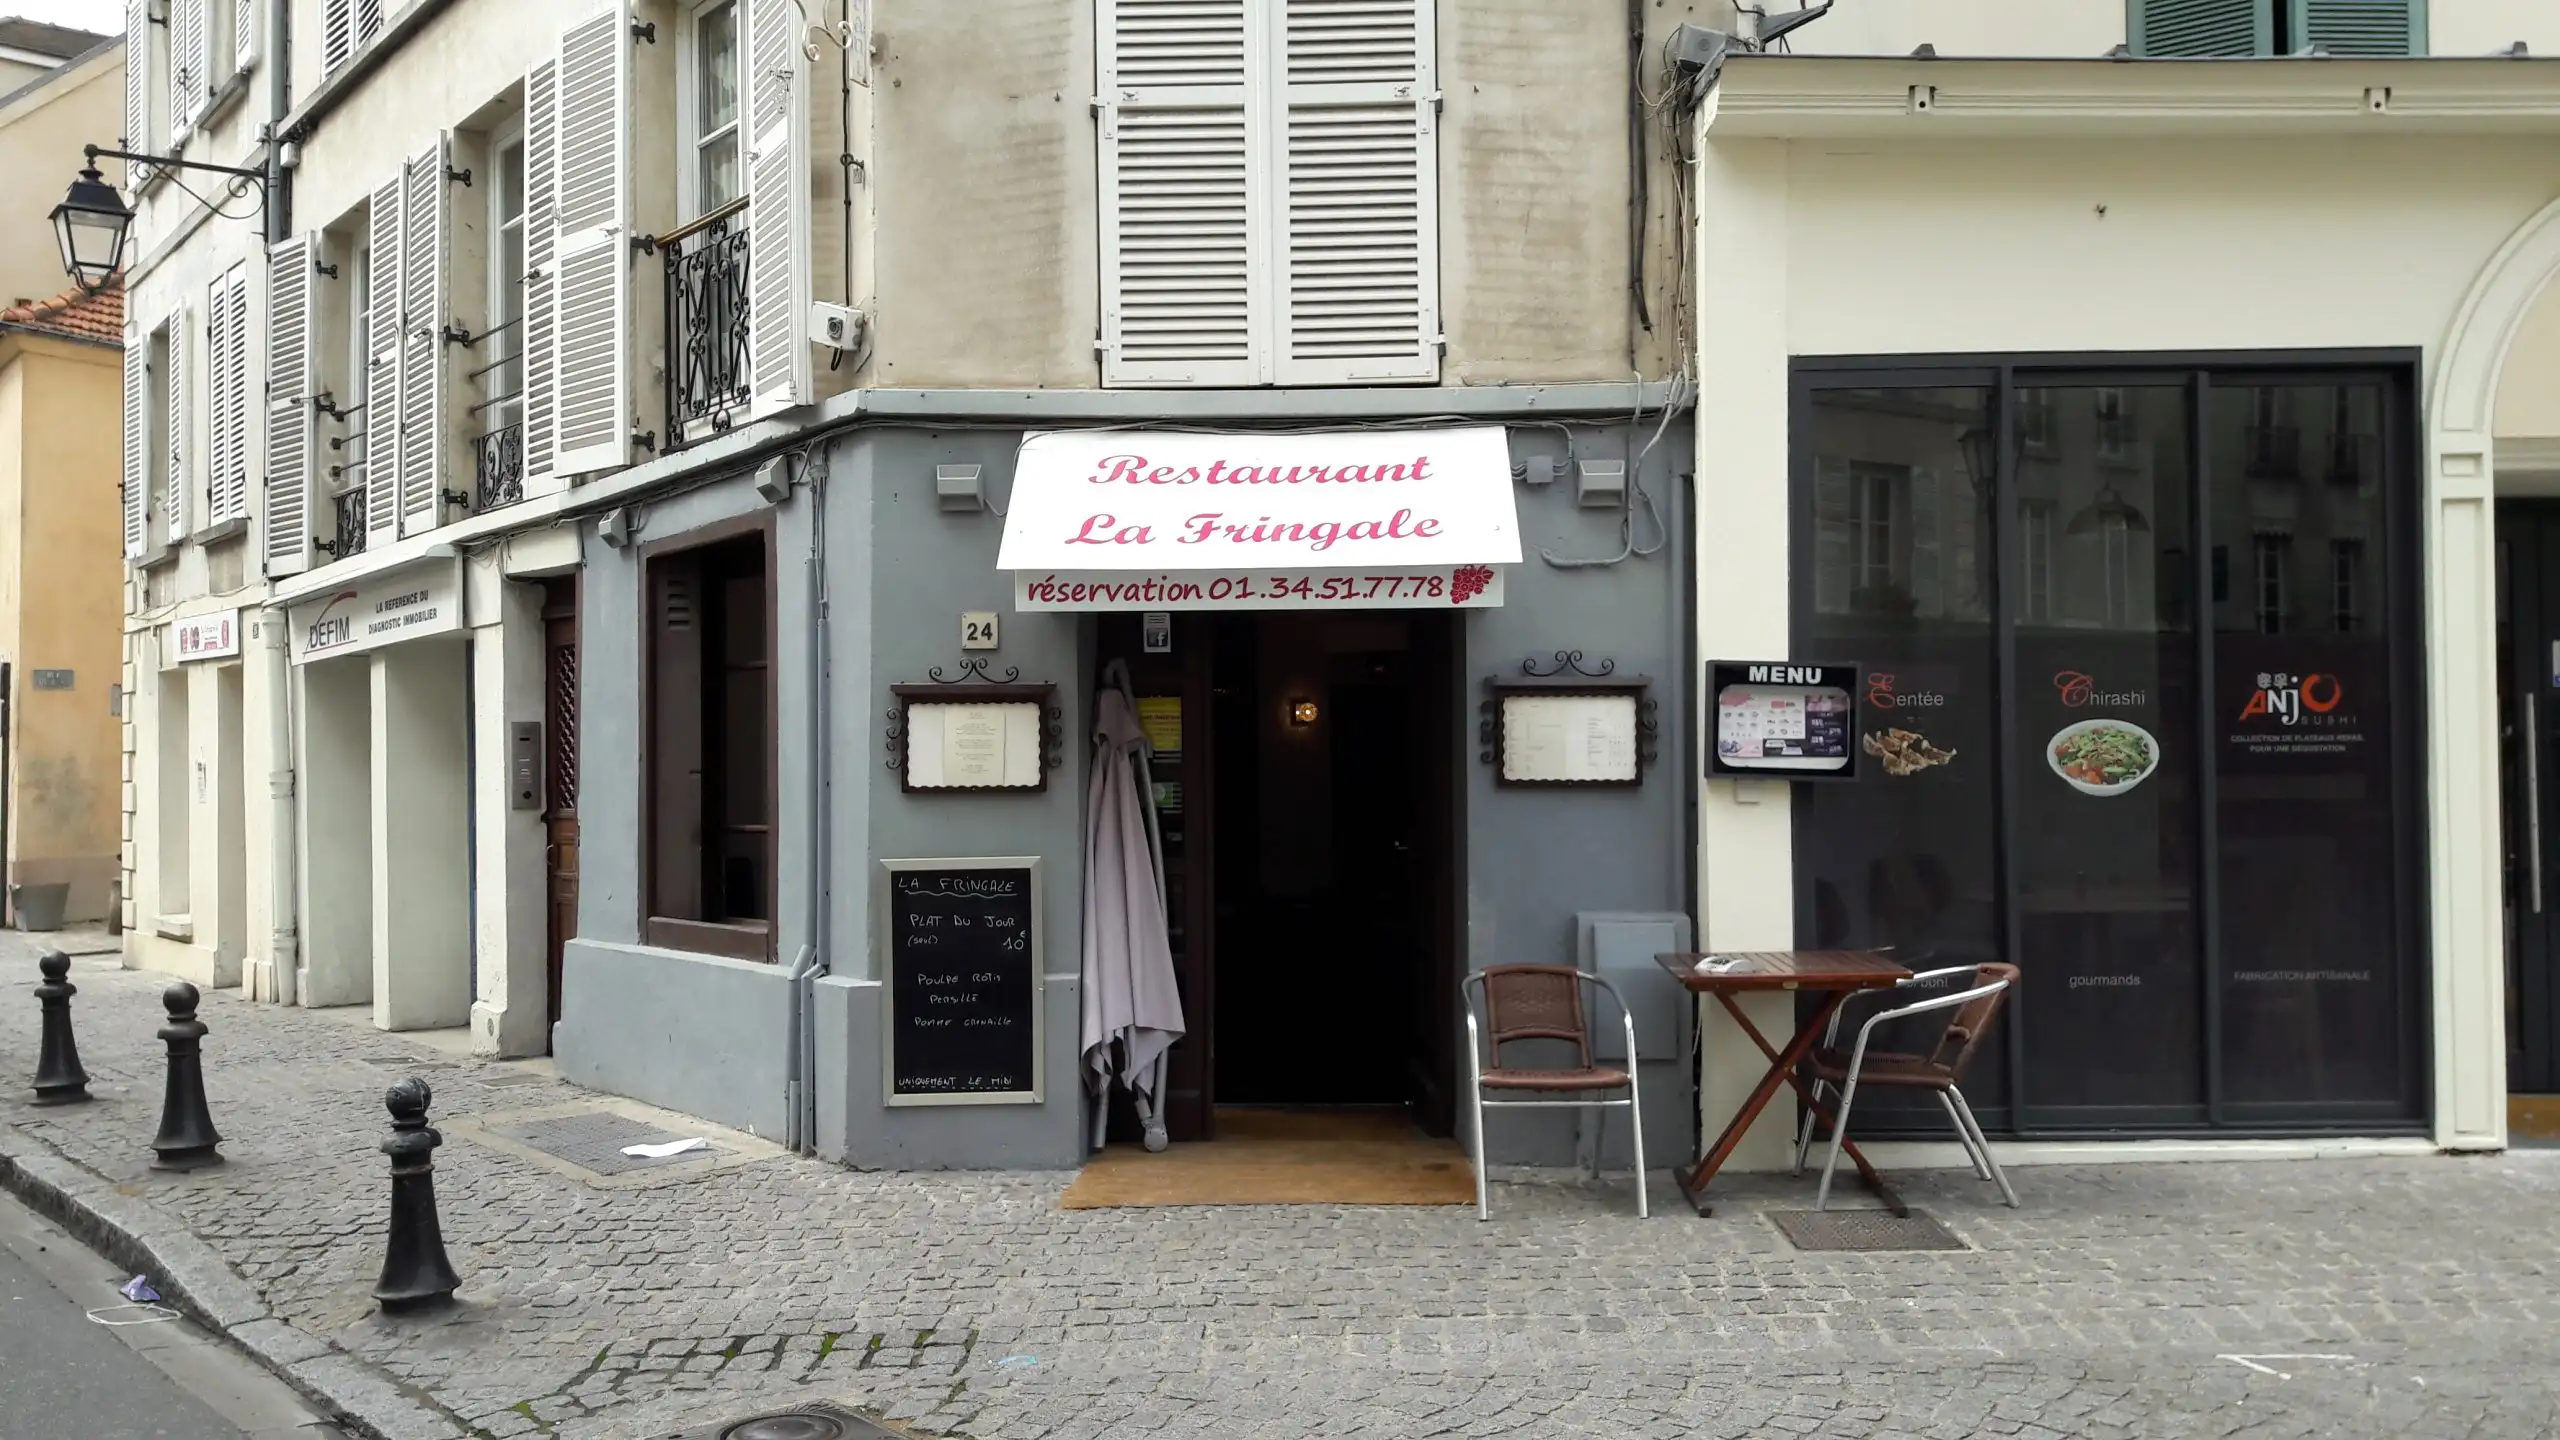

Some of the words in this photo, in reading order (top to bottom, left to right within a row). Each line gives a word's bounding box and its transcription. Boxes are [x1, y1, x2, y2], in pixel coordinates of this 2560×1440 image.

[1088, 454, 1433, 485] Restaurant
[1064, 513, 1156, 545] La
[1177, 508, 1443, 551] Fringale
[1028, 573, 1203, 603] réservation
[1208, 576, 1444, 600] 01.34.51.77.78
[376, 602, 383, 613] LA
[420, 590, 429, 602] DU
[310, 616, 350, 648] DEFIM
[368, 617, 401, 634] DIAGNOSTIC
[403, 608, 438, 626] IMMOBILIER
[967, 623, 993, 640] 24
[1749, 666, 1822, 684] MENU
[2054, 670, 2145, 707] Chirashi
[899, 877, 919, 888] LA
[910, 914, 944, 927] PLAT
[953, 914, 971, 926] DU
[984, 915, 1016, 927] JOUR
[2069, 974, 2141, 989] gourmands
[968, 1077, 983, 1085] LE
